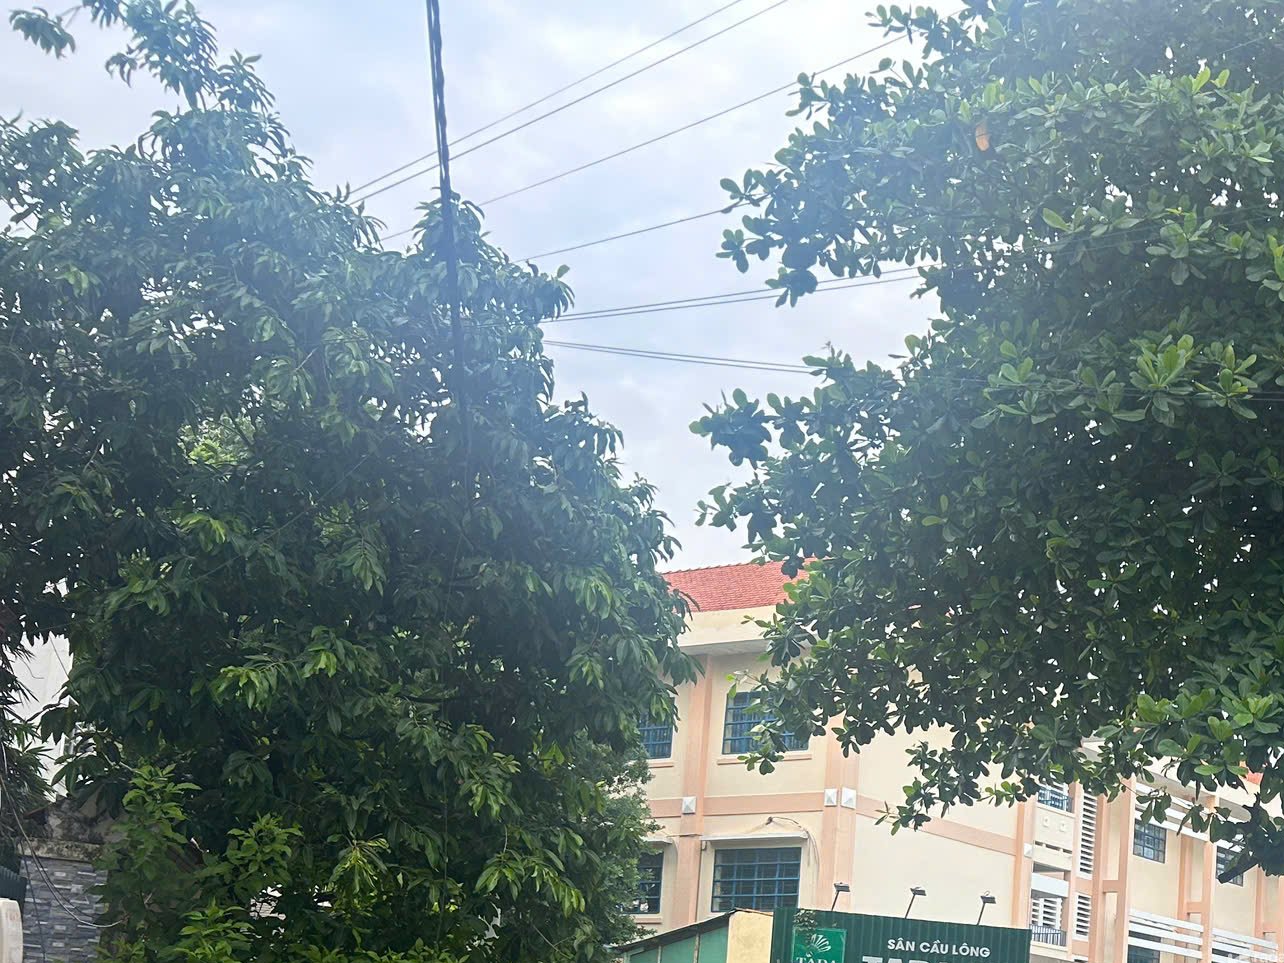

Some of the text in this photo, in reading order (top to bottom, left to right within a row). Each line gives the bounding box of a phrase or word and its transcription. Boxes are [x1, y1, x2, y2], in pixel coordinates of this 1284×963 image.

[887, 937, 991, 958] SÂN CẦU LÔNG
